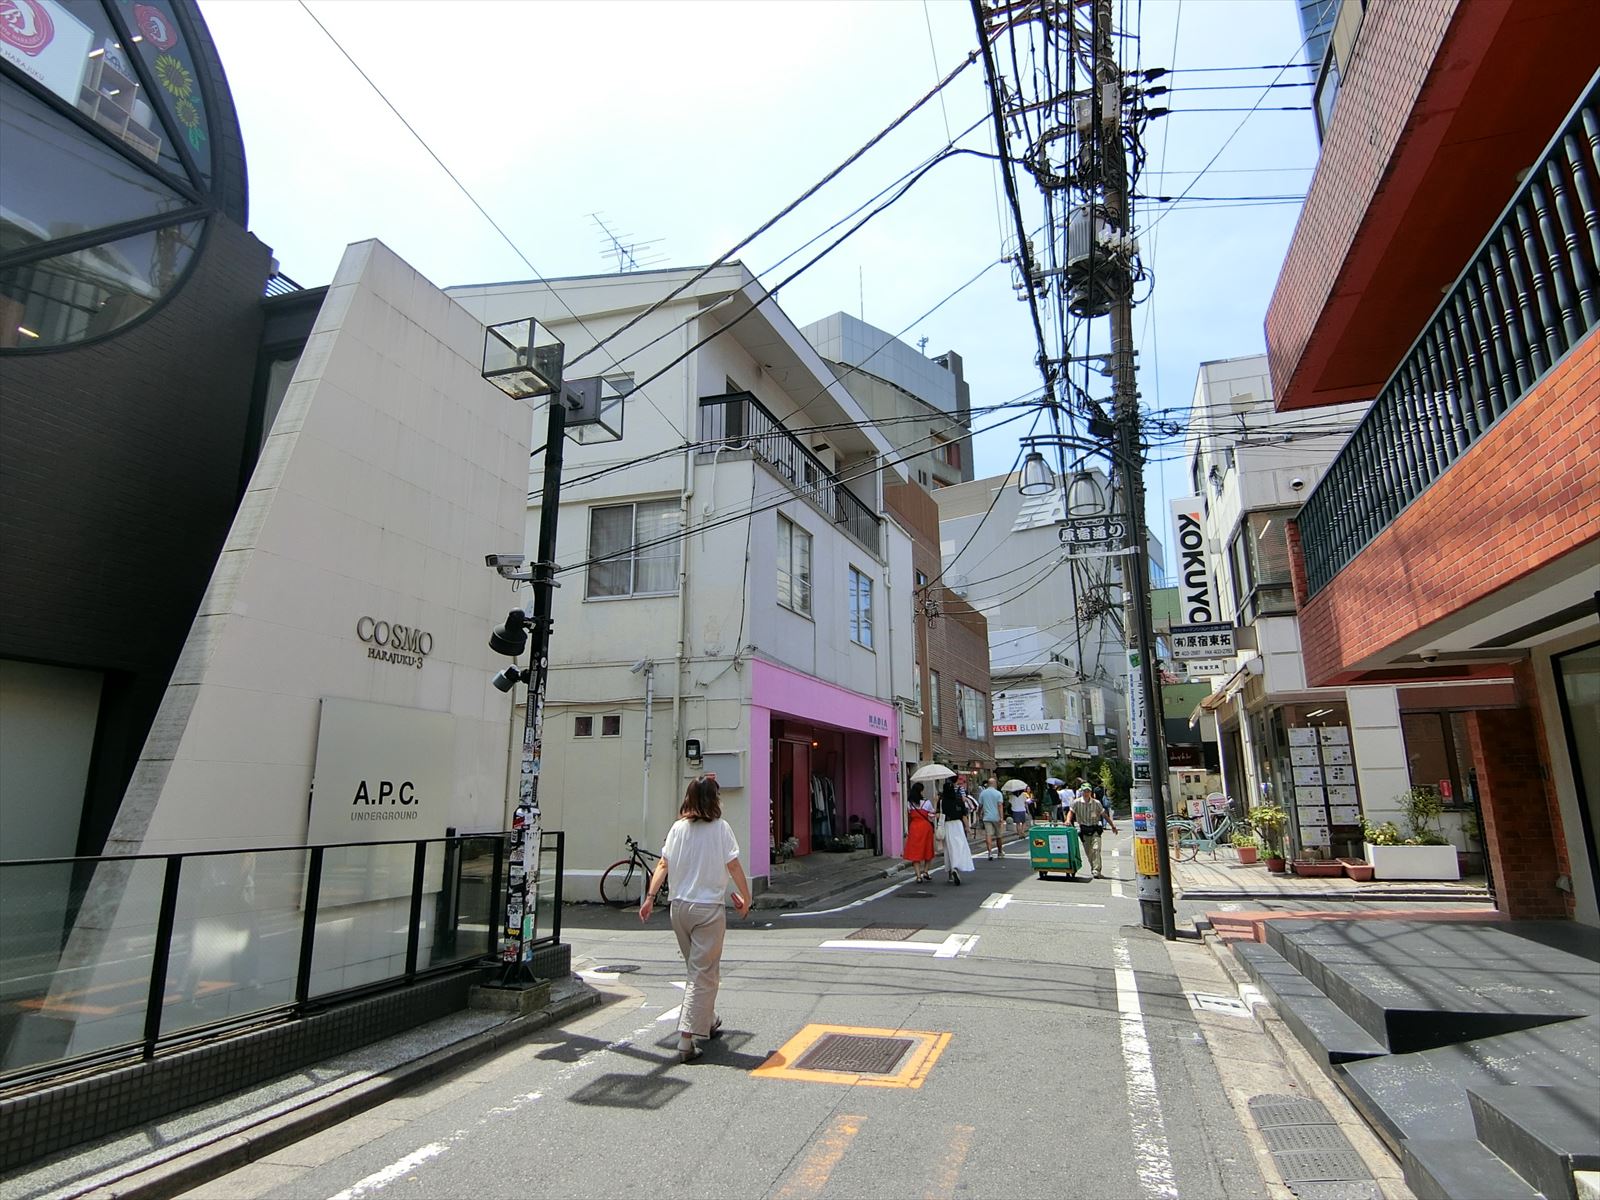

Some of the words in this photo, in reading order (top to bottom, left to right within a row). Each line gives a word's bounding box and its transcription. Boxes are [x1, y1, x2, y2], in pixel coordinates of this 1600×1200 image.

[4, 50, 46, 81] HARAJUKU
[1061, 524, 1122, 541] 原宿通り
[1177, 511, 1212, 623] KOKUYO
[356, 615, 433, 656] COSMO
[352, 780, 419, 806] A.P.C.
[350, 810, 418, 821] UNDERGROUND
